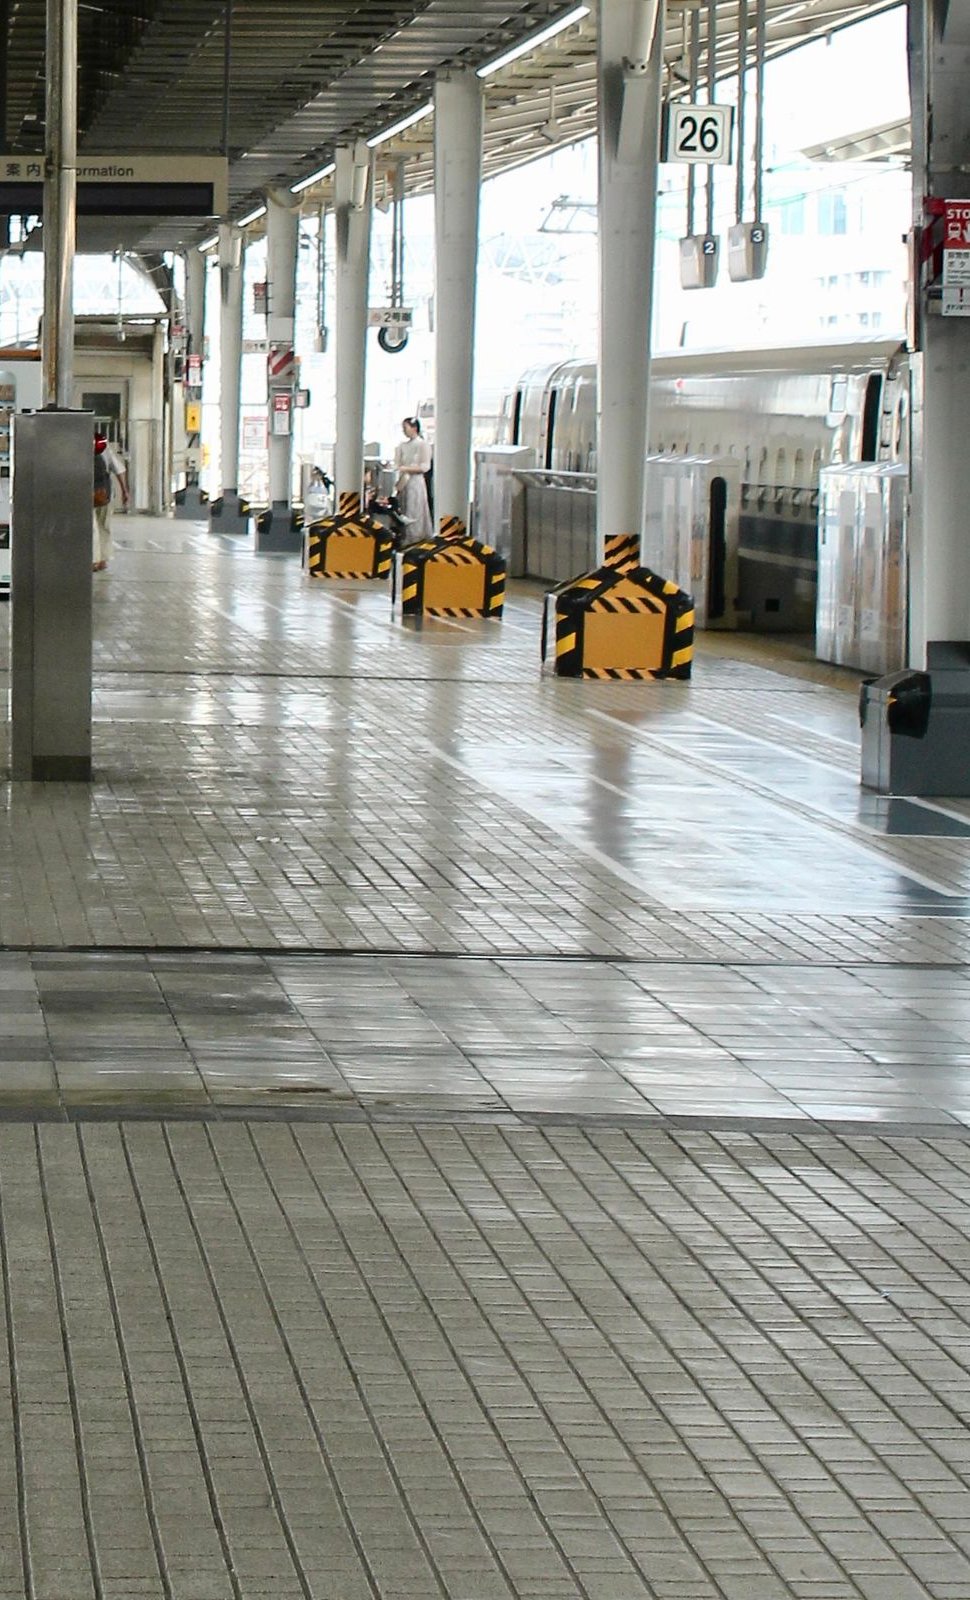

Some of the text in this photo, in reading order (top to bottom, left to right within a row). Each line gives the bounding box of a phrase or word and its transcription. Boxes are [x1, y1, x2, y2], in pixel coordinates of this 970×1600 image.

[679, 116, 719, 152] 26
[75, 164, 134, 177] ormation
[753, 230, 763, 242] 3
[704, 242, 715, 254] 2
